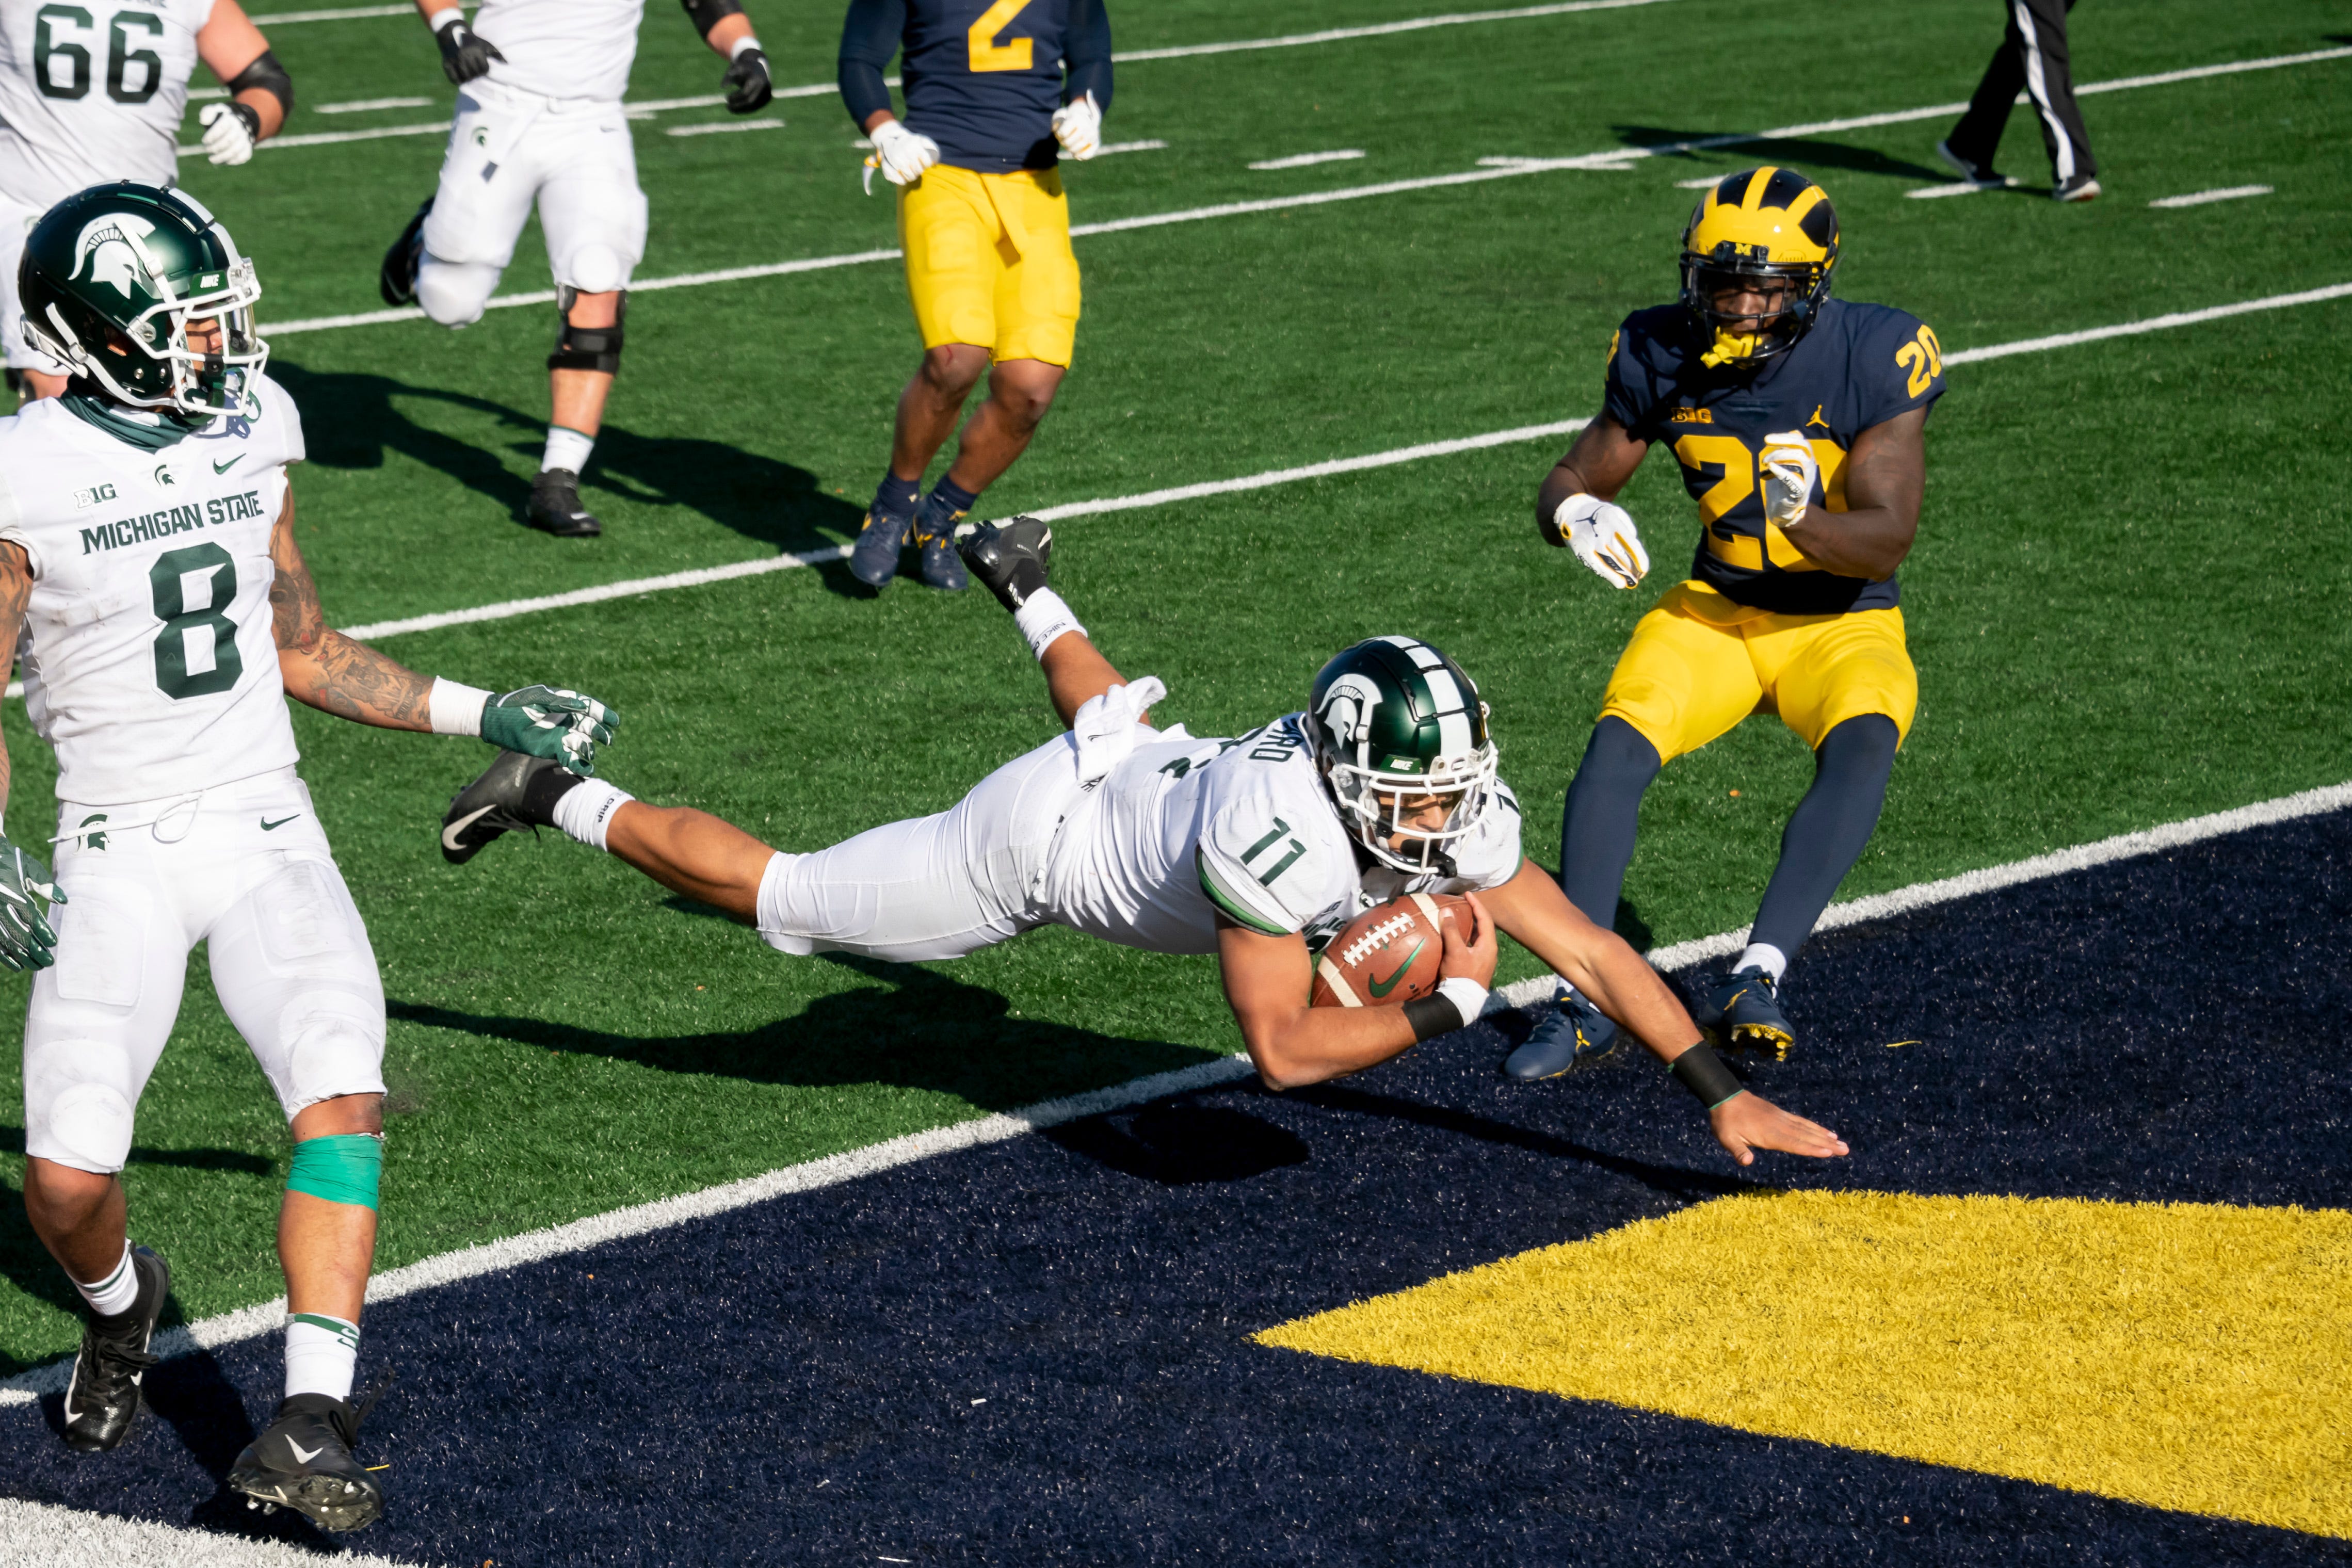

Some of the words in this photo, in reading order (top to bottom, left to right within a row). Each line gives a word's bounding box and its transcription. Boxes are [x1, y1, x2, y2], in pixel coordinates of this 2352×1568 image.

[34, 4, 164, 104] 66
[968, 0, 1034, 72] 2
[200, 274, 219, 288] NIKE
[1735, 243, 1753, 255] M
[1895, 324, 1941, 399] 20
[79, 503, 204, 555] MICHIGAN
[207, 490, 264, 525] STATE
[149, 542, 244, 700] 8
[1042, 621, 1067, 643] NIKE
[1390, 759, 1413, 771] NIKE
[598, 798, 615, 823] GRIP
[1239, 816, 1307, 887] 11
